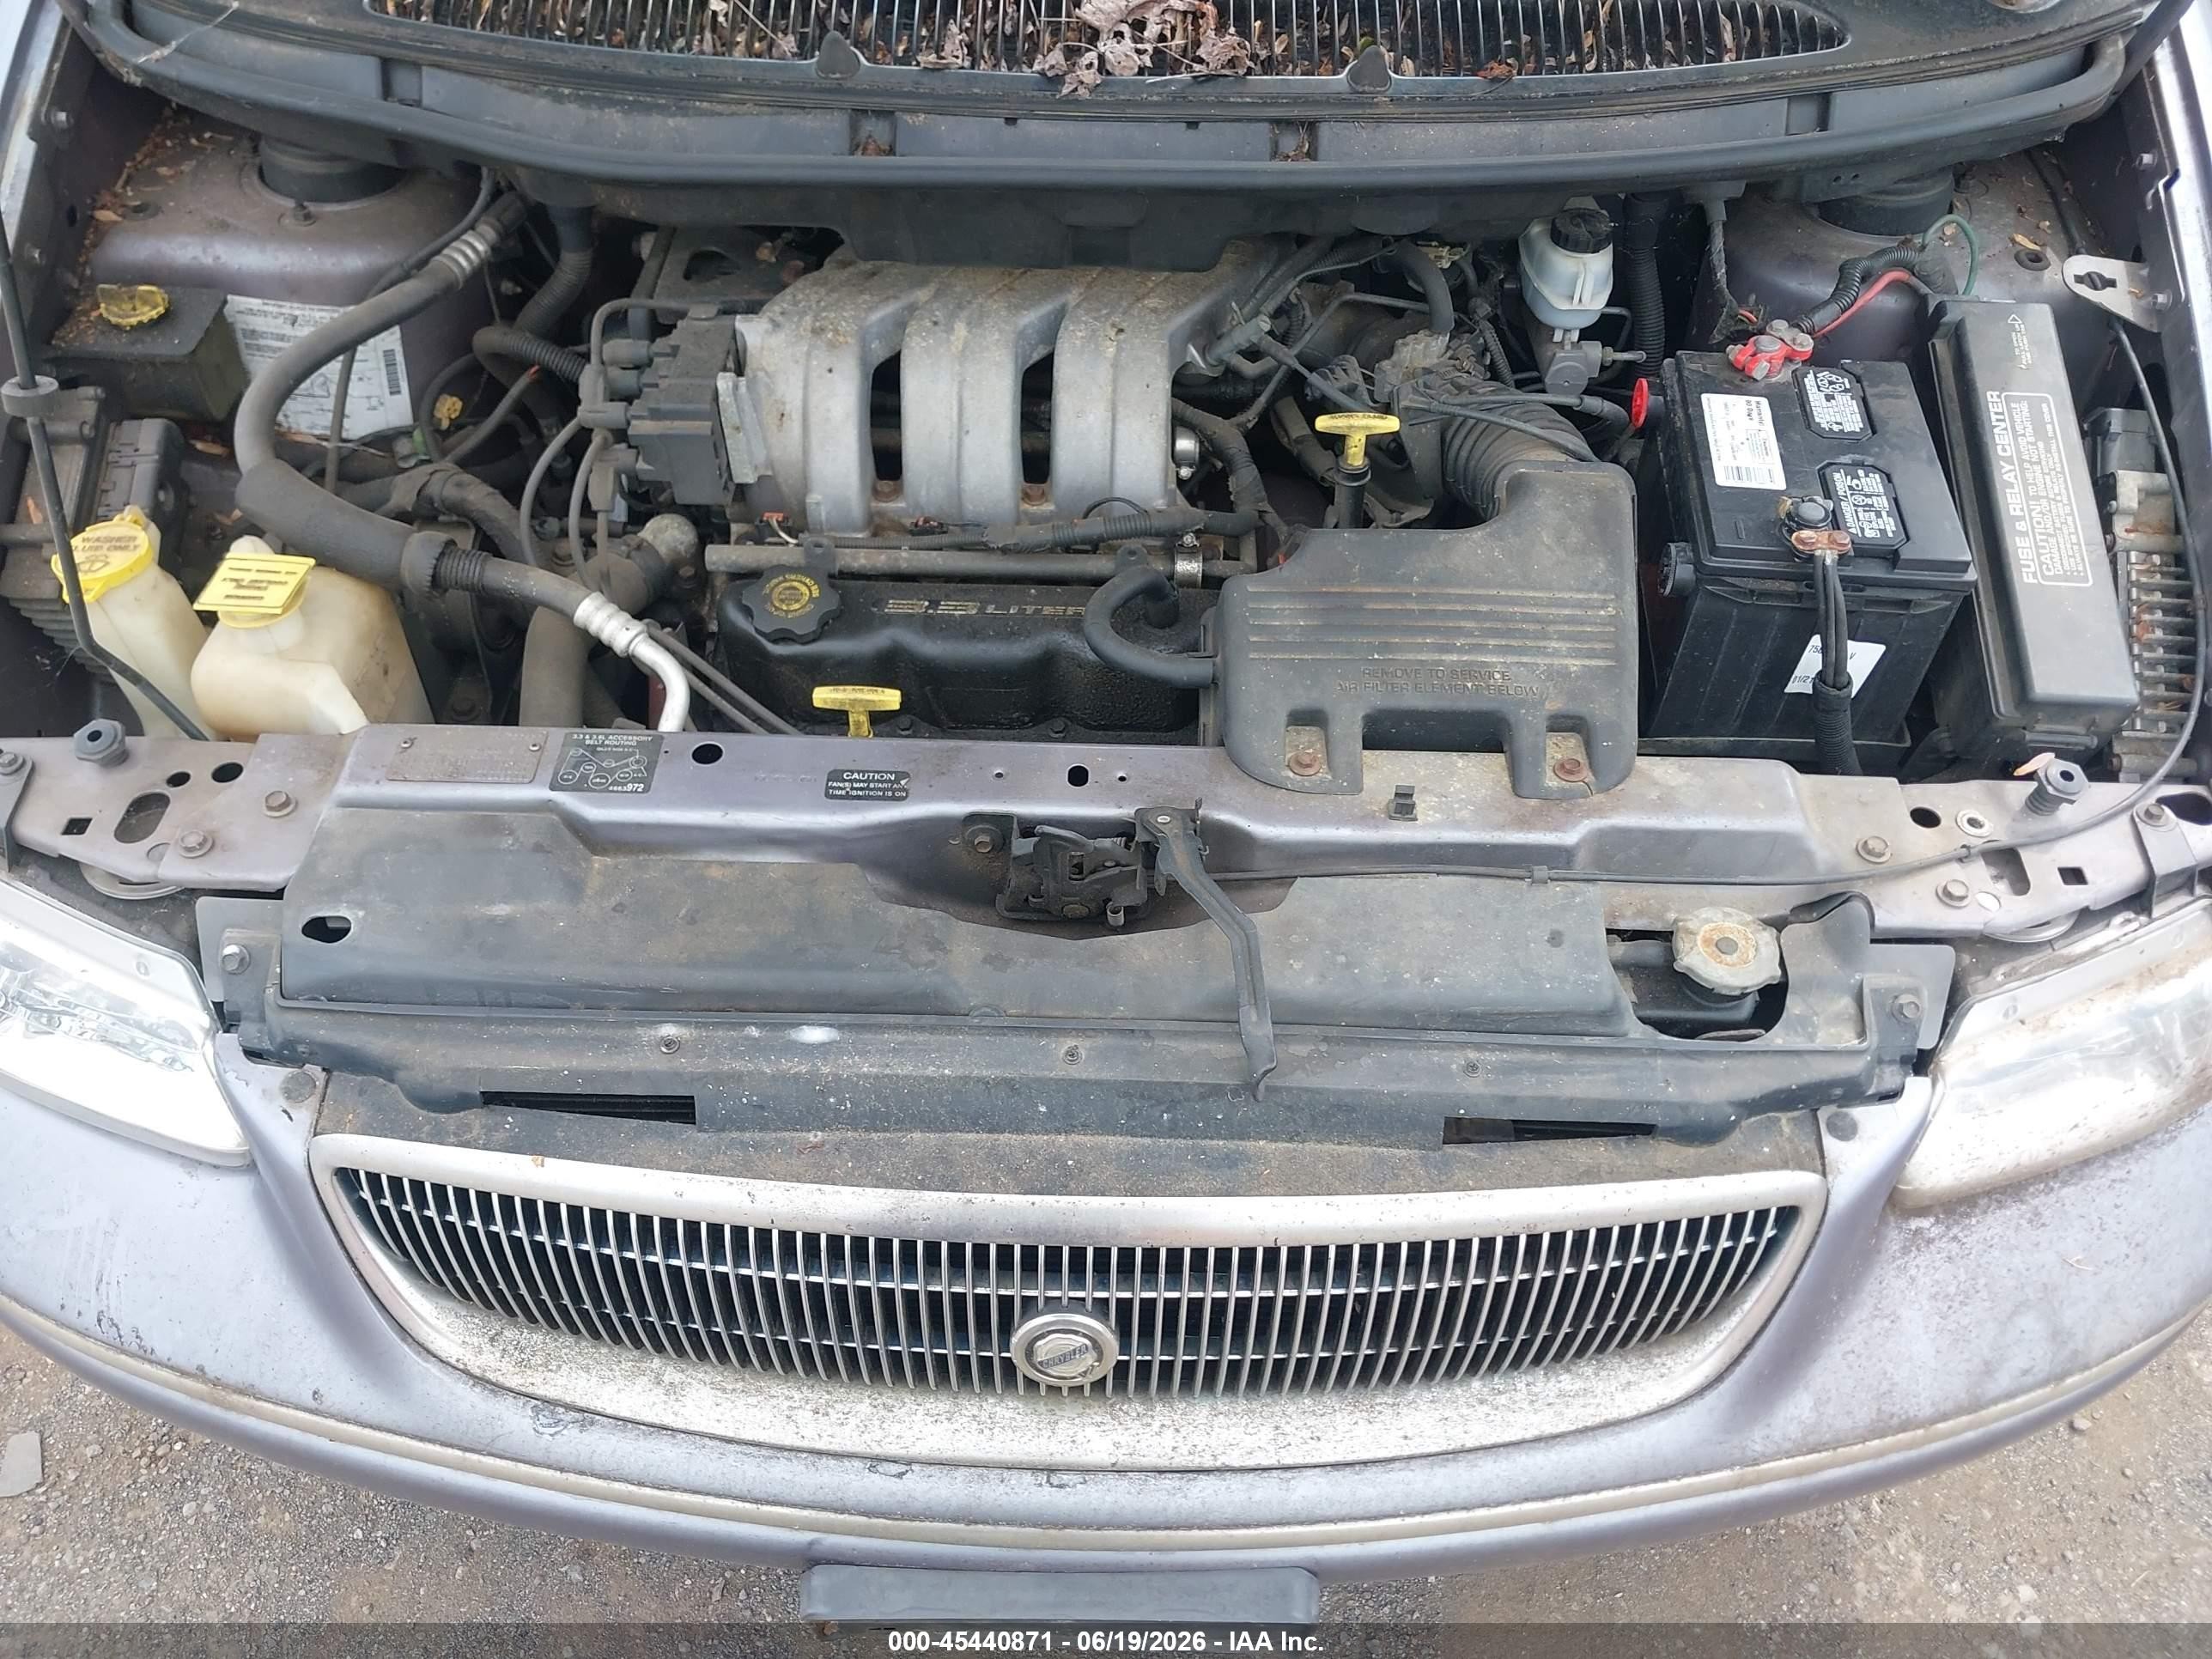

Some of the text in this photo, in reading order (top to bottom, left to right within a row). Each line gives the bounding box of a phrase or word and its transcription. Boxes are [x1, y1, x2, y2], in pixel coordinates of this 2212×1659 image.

[1832, 473, 1846, 495] POISON
[1986, 391, 2038, 583] FUSE & RELAY CENTER
[2010, 403, 2054, 575] CAUTION! TO HELP AVOID VEHICLE
[2020, 400, 2063, 574] DAMAGE AND/OR ENGINE NOT STARTING:
[1840, 501, 1855, 527] DANGER
[106, 544, 141, 552] ONLY
[884, 599, 980, 615] 3.3
[1362, 667, 1511, 681] REMOVE TO SERVICE
[1337, 681, 1539, 696] AIR FILTER ELEMENT BELOW
[843, 772, 896, 781] CAUTION
[1042, 1343, 1089, 1369] CHRYSLER
